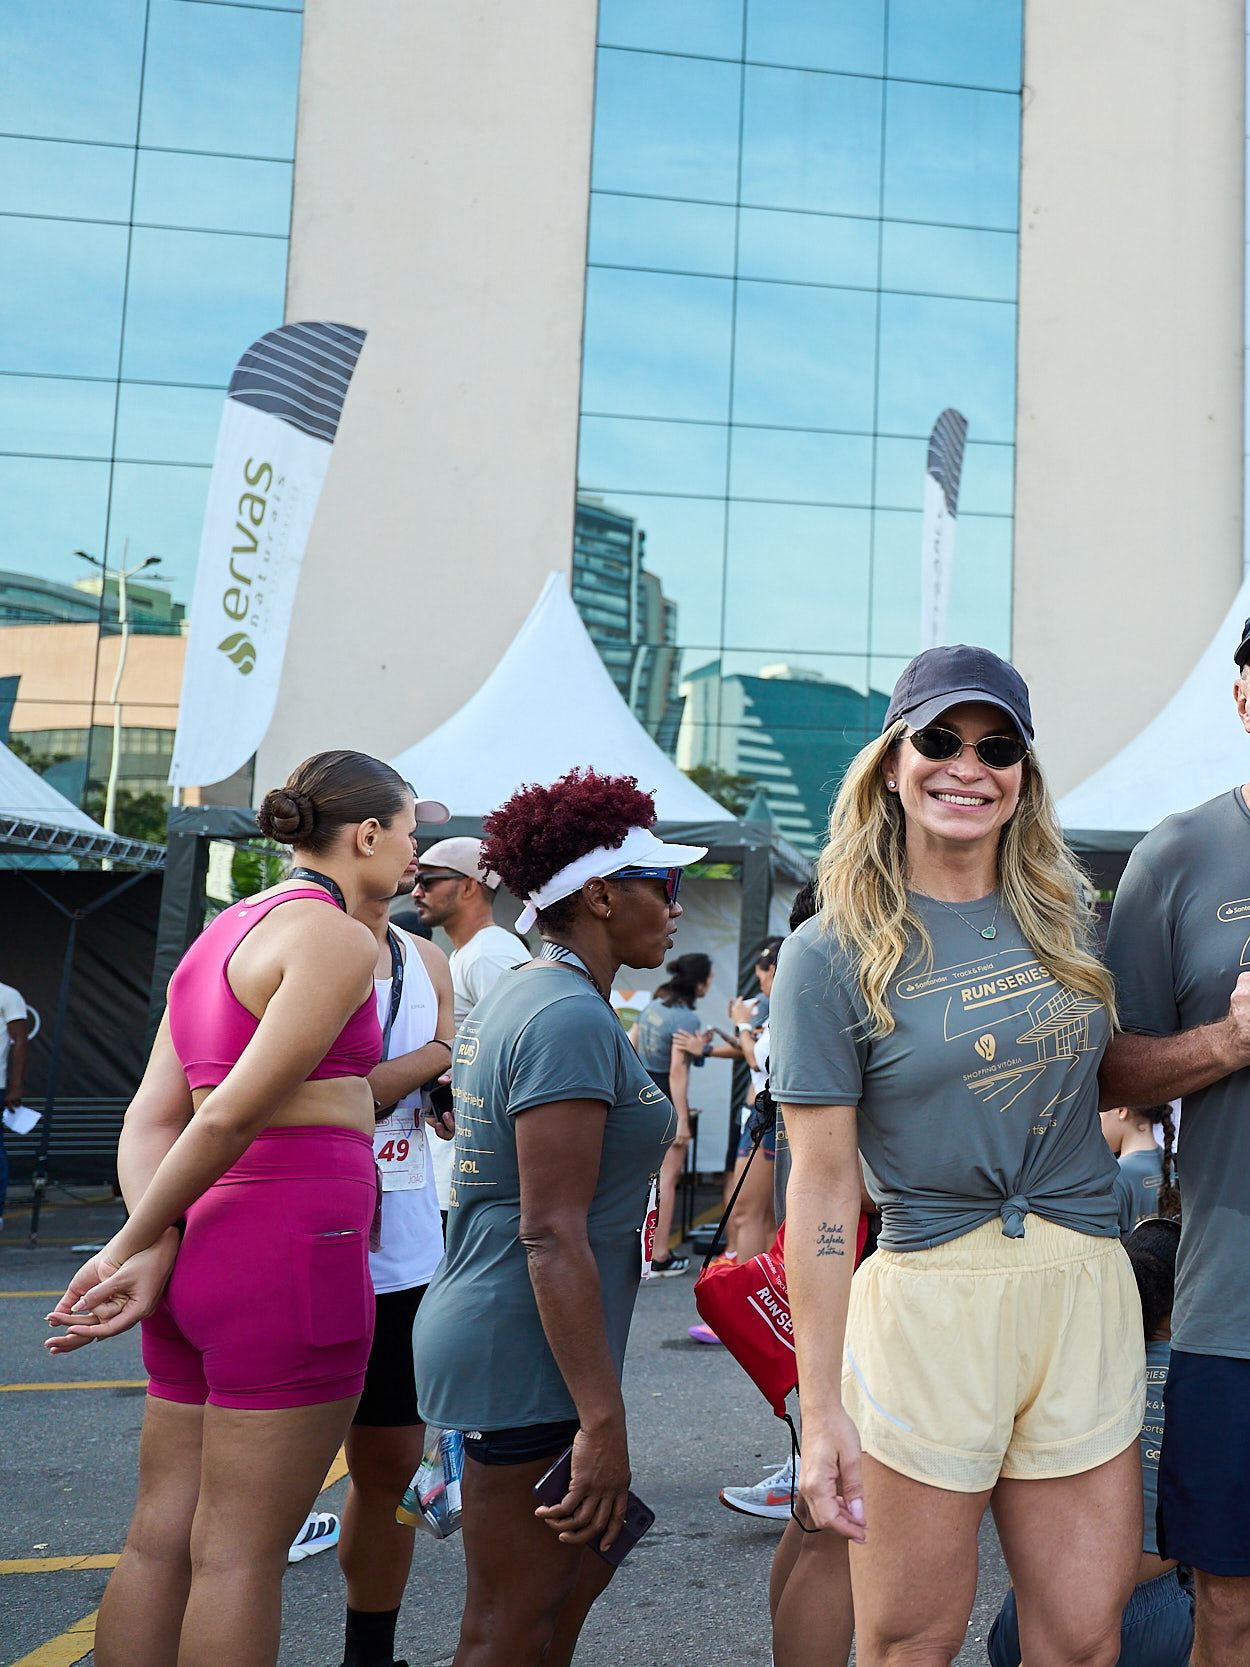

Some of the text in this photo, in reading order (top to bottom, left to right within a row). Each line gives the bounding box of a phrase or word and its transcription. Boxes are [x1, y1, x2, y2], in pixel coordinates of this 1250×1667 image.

[222, 457, 273, 622] ervas
[915, 963, 994, 990] Santander Track&Field
[962, 1057, 1022, 1081] SHOPPING VITÓRIA
[459, 1160, 479, 1173] GOL
